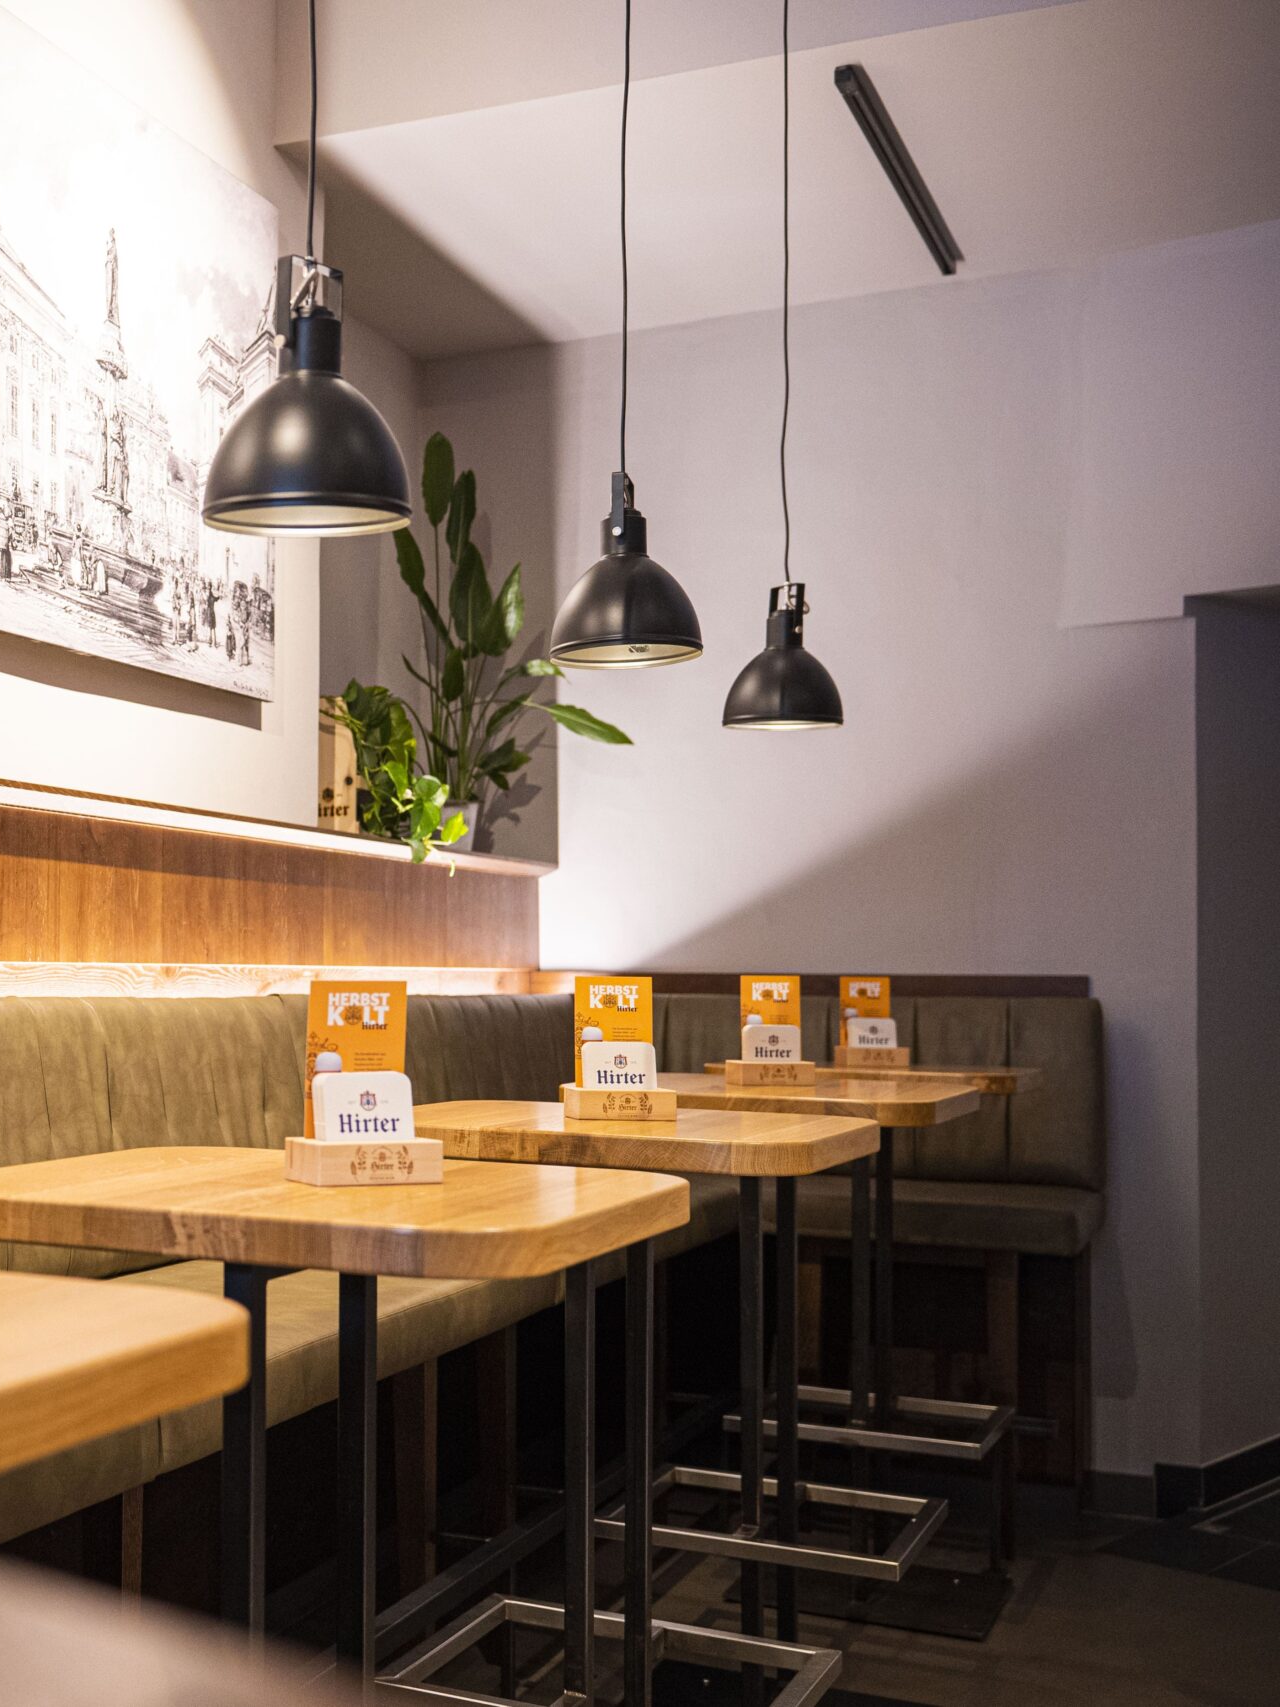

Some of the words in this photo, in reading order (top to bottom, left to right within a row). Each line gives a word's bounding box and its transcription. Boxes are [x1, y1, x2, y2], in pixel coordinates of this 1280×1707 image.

[589, 985, 639, 995] HERBST
[328, 992, 391, 1006] HERBST
[361, 1021, 388, 1031] Hirter
[755, 1046, 792, 1058] Hirter
[597, 1069, 646, 1084] Hirter
[339, 1113, 400, 1133] Hirter
